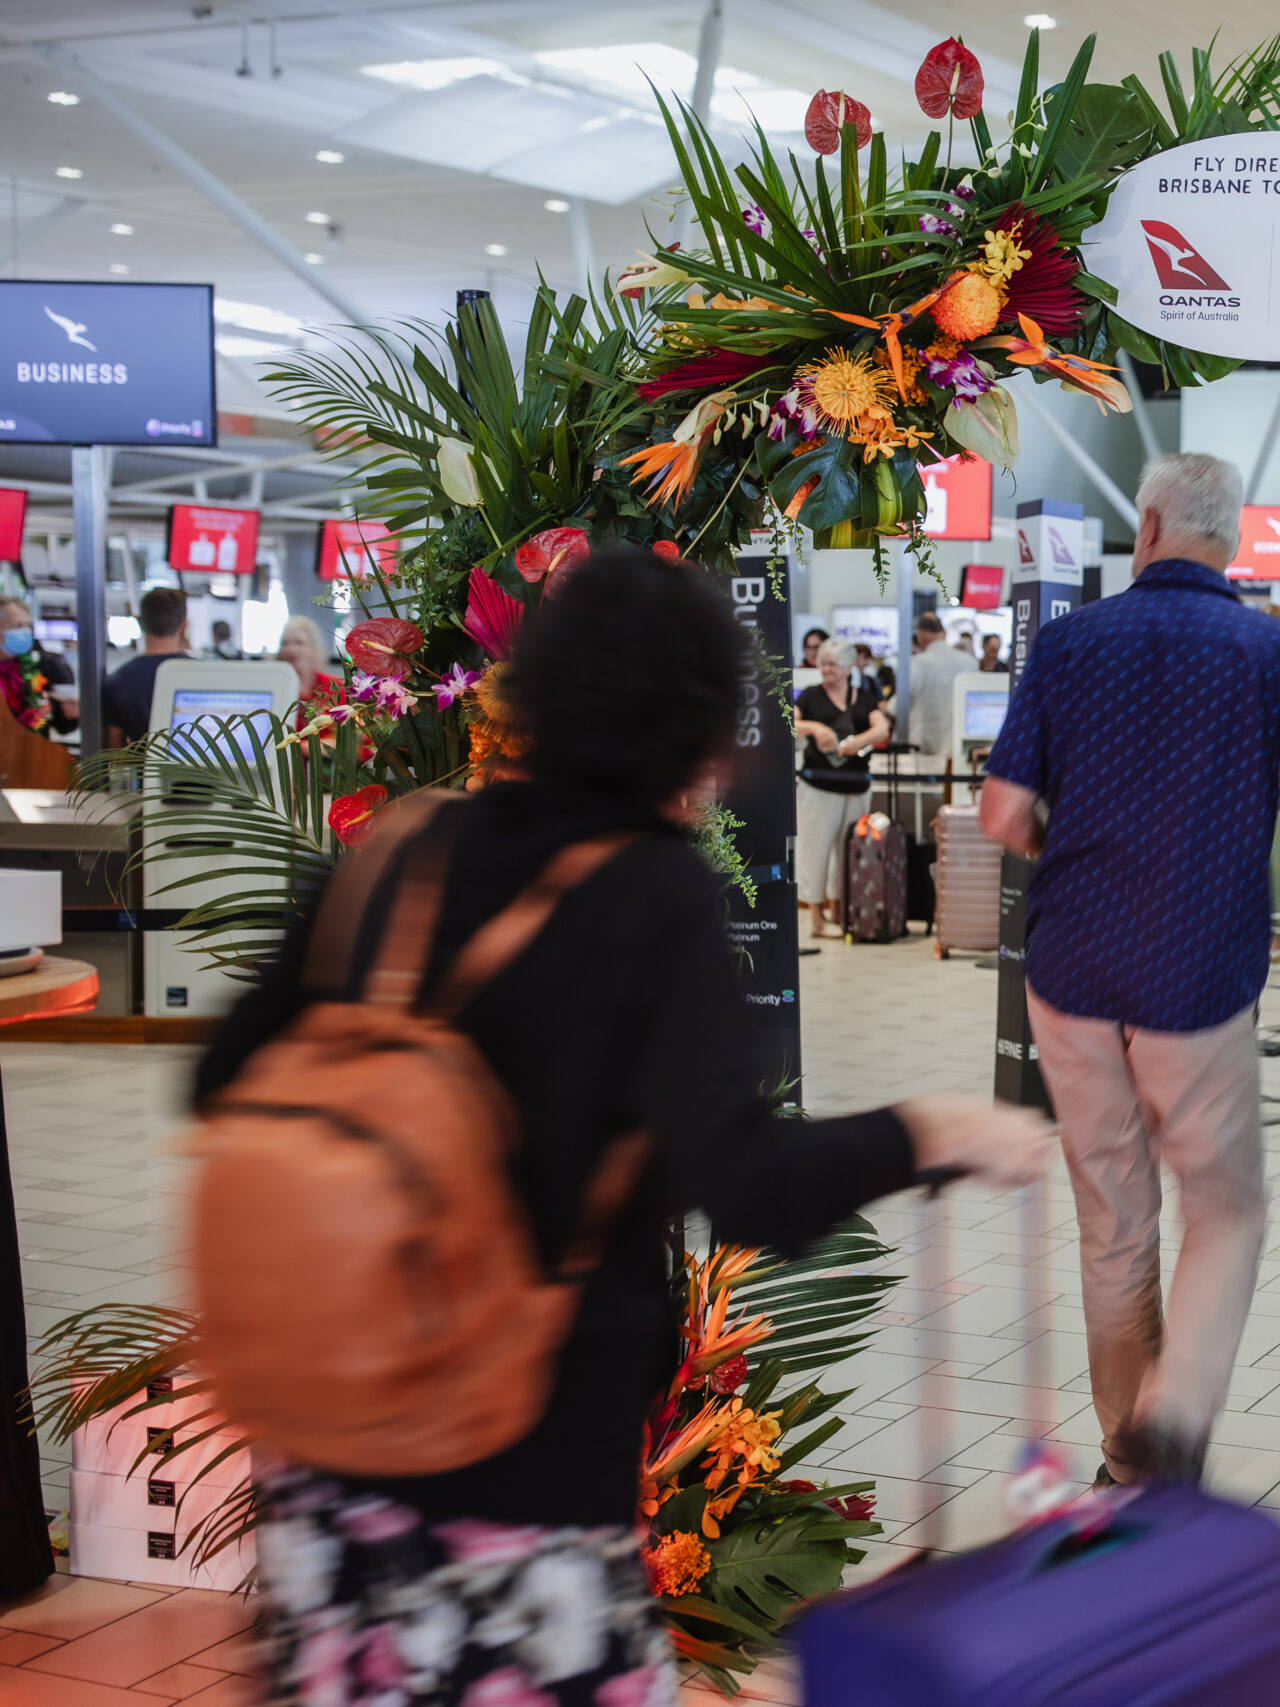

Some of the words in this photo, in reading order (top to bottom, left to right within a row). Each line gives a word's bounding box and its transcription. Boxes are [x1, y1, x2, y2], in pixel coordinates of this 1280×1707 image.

[1193, 156, 1226, 172] FLY
[1158, 178, 1253, 195] BRISBANE
[1158, 294, 1242, 308] QANTAS
[1160, 310, 1185, 321] Spirit
[1186, 310, 1197, 321] of
[1198, 311, 1240, 322] Australia
[16, 361, 129, 385] BUSINESS
[760, 920, 778, 930] One
[745, 992, 782, 1007] Priority
